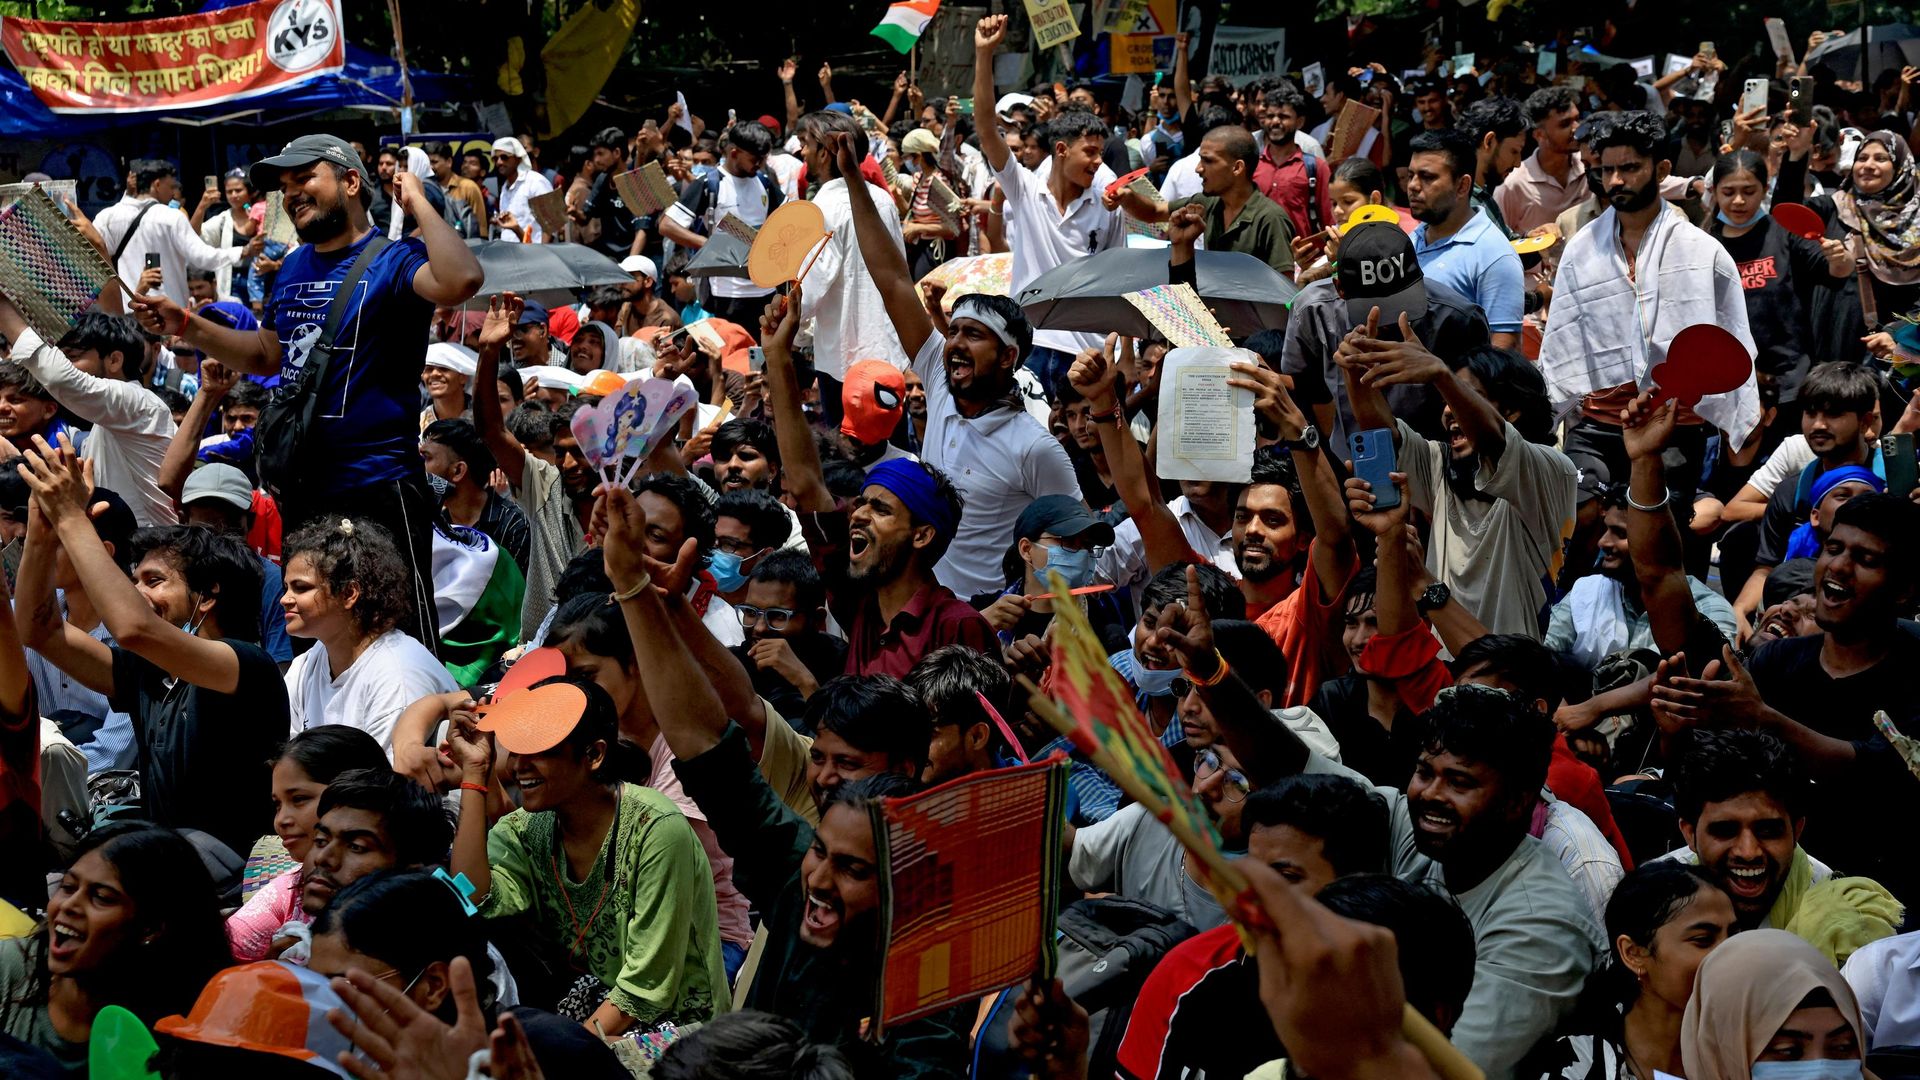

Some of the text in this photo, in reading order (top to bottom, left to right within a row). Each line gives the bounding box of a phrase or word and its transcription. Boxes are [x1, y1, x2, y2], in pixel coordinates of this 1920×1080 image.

[85, 29, 105, 60] हो
[106, 35, 131, 56] या
[133, 31, 184, 61] मजदूर
[185, 27, 211, 48] का
[211, 18, 256, 44] बच्चा
[274, 18, 329, 54] KYS
[82, 61, 133, 95] मिले
[134, 65, 195, 95] समान
[196, 48, 264, 89] शिक्षा!
[1130, 56, 1153, 65] ROA
[325, 149, 347, 161] adidas
[1360, 252, 1404, 285] BOY
